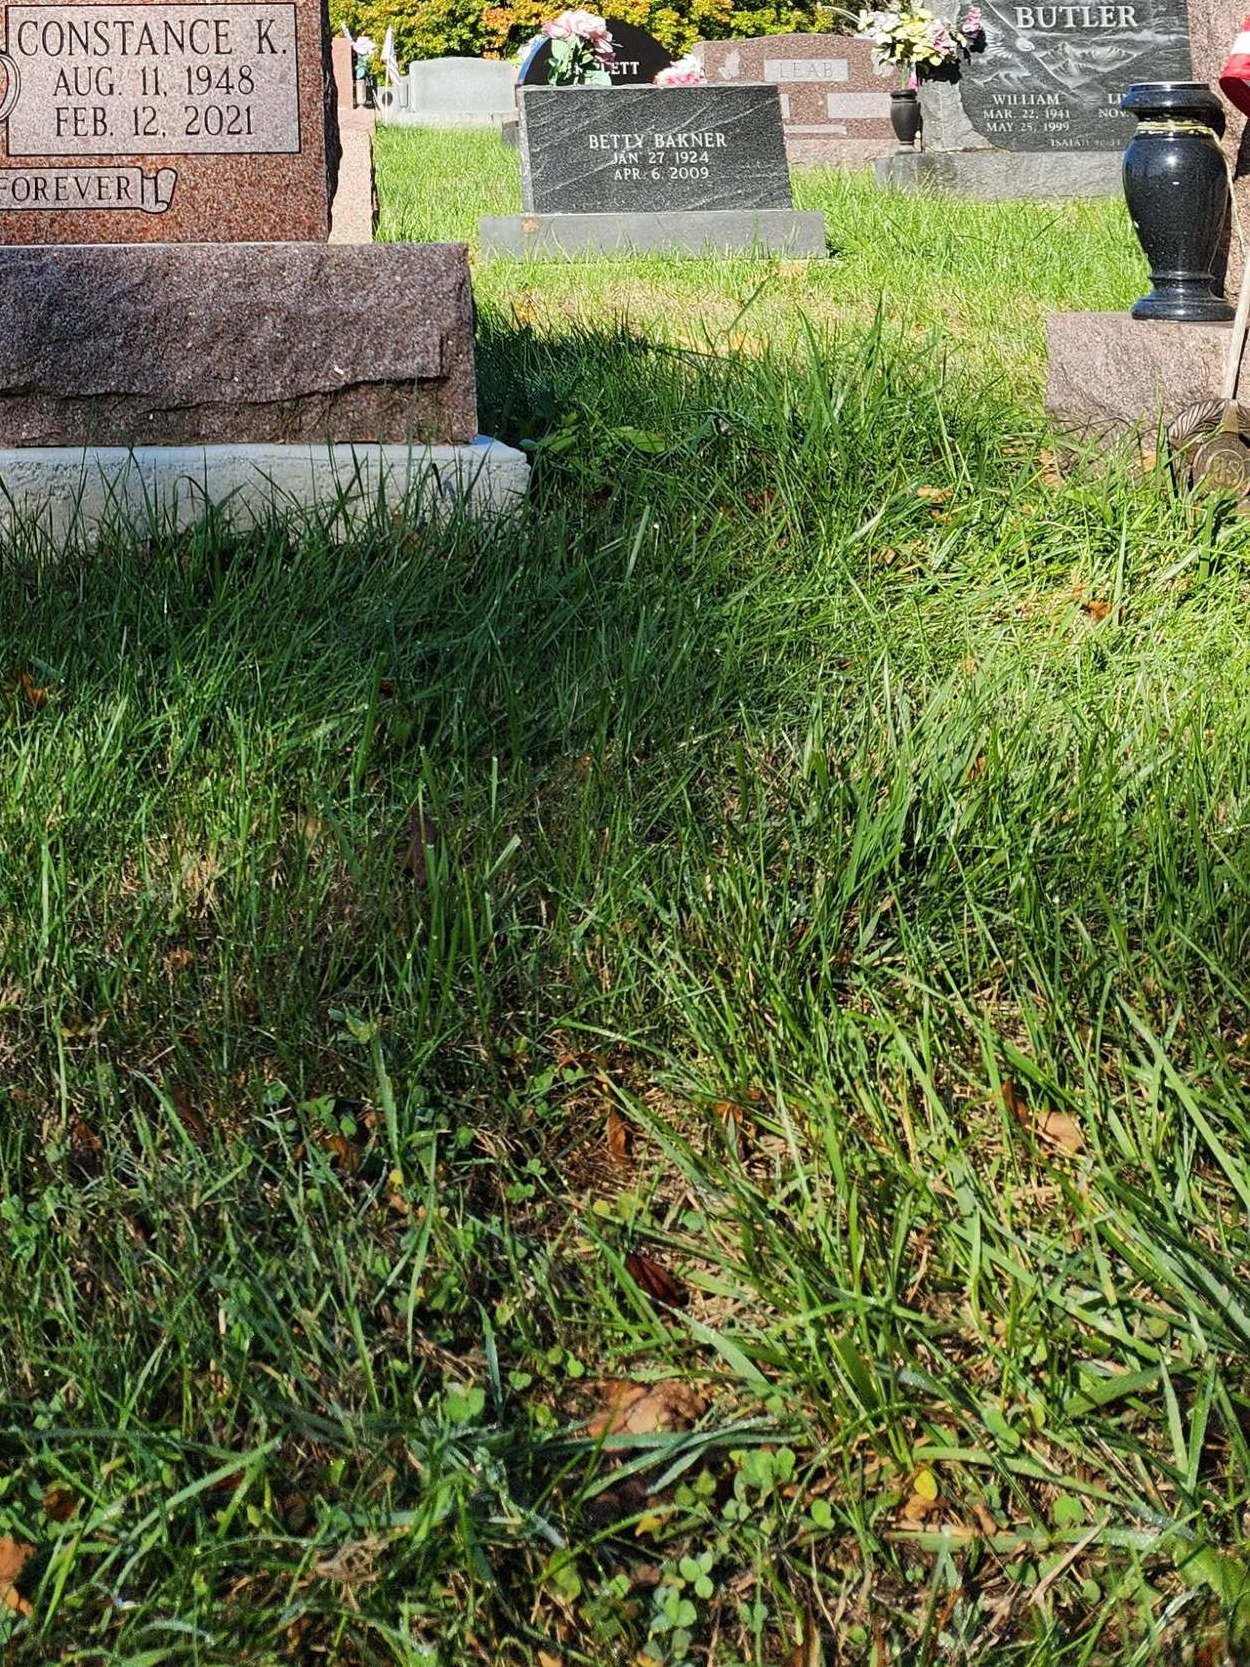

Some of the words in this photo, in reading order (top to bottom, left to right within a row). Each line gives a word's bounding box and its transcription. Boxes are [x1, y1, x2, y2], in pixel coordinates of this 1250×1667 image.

[1013, 5, 1139, 28] BUTLER
[17, 19, 233, 57] CONSTANCE
[256, 19, 287, 55] K.
[779, 62, 833, 78] LEAB
[52, 66, 123, 96] AUG.
[141, 66, 167, 98] 11,
[186, 65, 255, 96] 1948
[992, 93, 1060, 105] WILLIAM
[55, 107, 114, 137] FEB.
[133, 106, 167, 138] 12,
[185, 105, 253, 136] 2021
[983, 108, 1017, 119] MAR.
[1045, 108, 1070, 119] 1941
[986, 122, 1014, 132] MAY
[1044, 121, 1070, 132] 1999
[588, 134, 645, 149] BETTY
[654, 133, 727, 148] BAKNER
[675, 150, 709, 163] 1924
[669, 166, 709, 180] 2009
